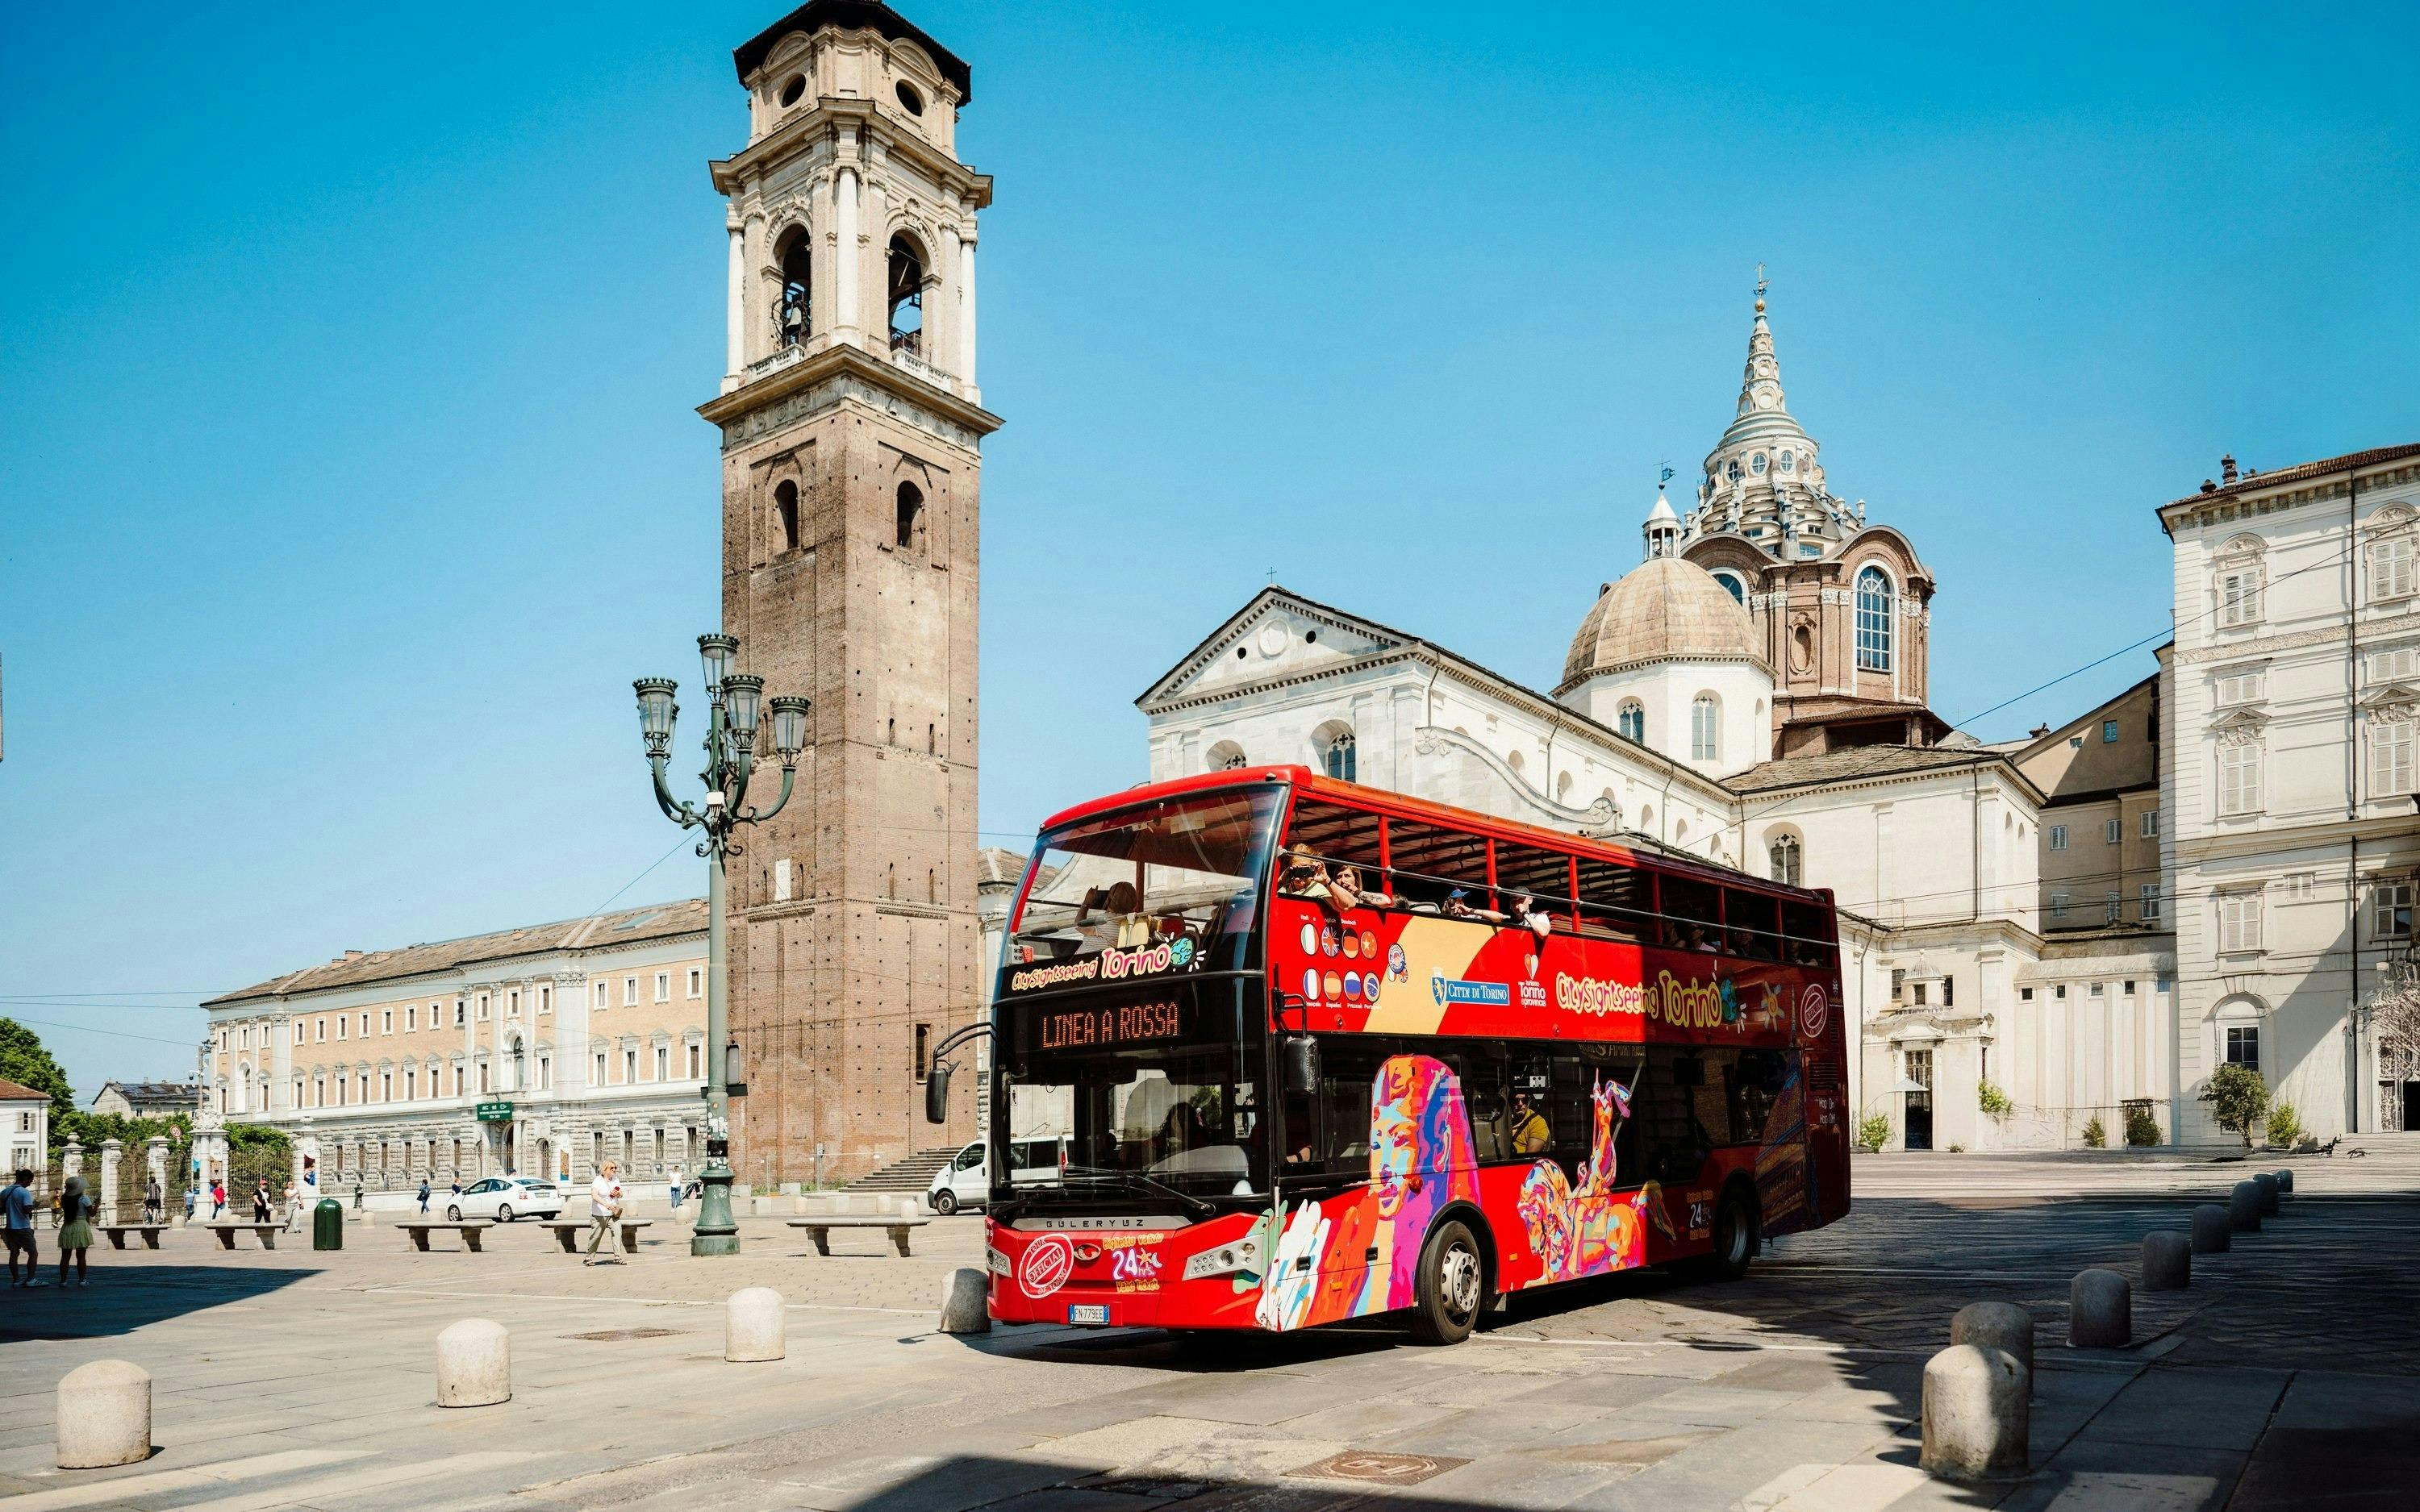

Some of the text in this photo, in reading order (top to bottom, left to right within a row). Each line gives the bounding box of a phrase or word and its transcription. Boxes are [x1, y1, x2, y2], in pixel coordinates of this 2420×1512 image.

[1012, 943, 1171, 991] CitySightseeing Torino
[1472, 986, 1480, 998] DI
[1480, 984, 1507, 1000] TORINO
[1517, 981, 1546, 1000] Torino
[1556, 969, 1722, 1028] CitySightseeing Torino
[1042, 1002, 1179, 1048] LINEA A ROSSA
[1690, 1203, 1702, 1228] 24
[1028, 1238, 1046, 1255] TOUR
[1028, 1248, 1063, 1281] OFFICIAL
[1112, 1248, 1137, 1281] 24
[1037, 1286, 1049, 1295] OF
